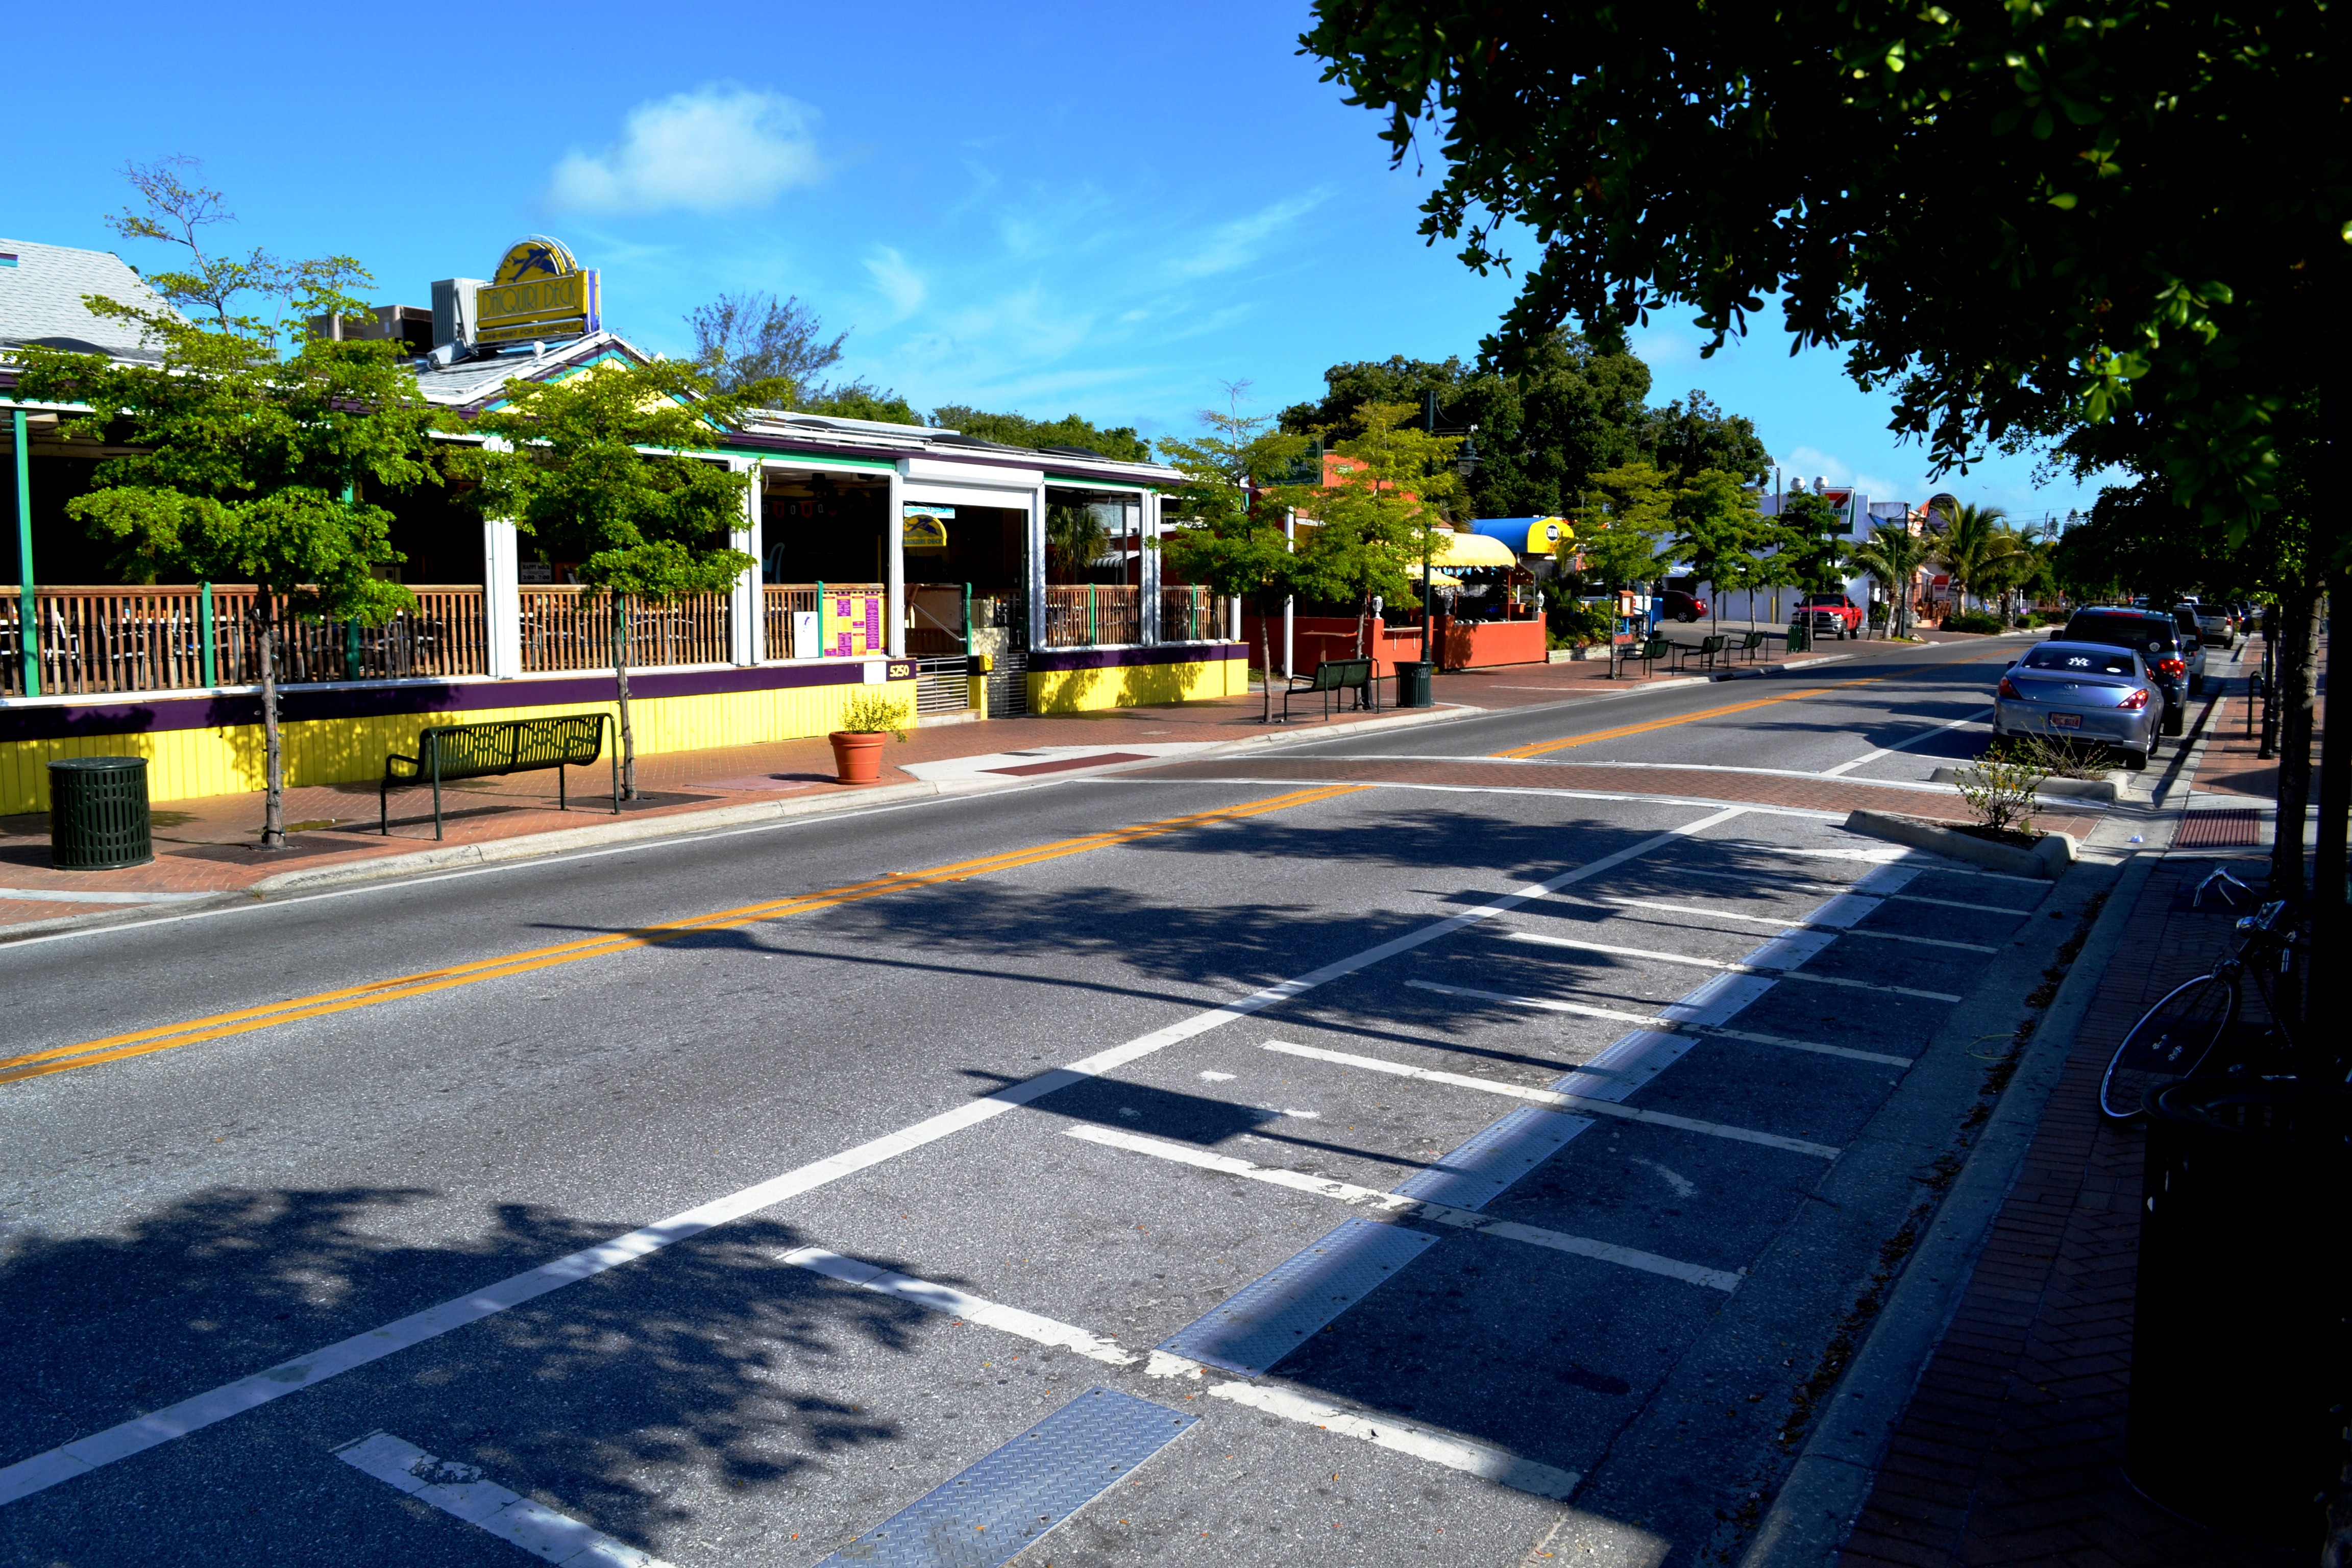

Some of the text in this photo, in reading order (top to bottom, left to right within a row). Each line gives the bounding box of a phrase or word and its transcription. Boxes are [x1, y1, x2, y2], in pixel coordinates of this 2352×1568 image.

[483, 281, 577, 316] DAIQUIRI DECK
[1825, 492, 1849, 508] 7
[889, 664, 910, 677] 5250
